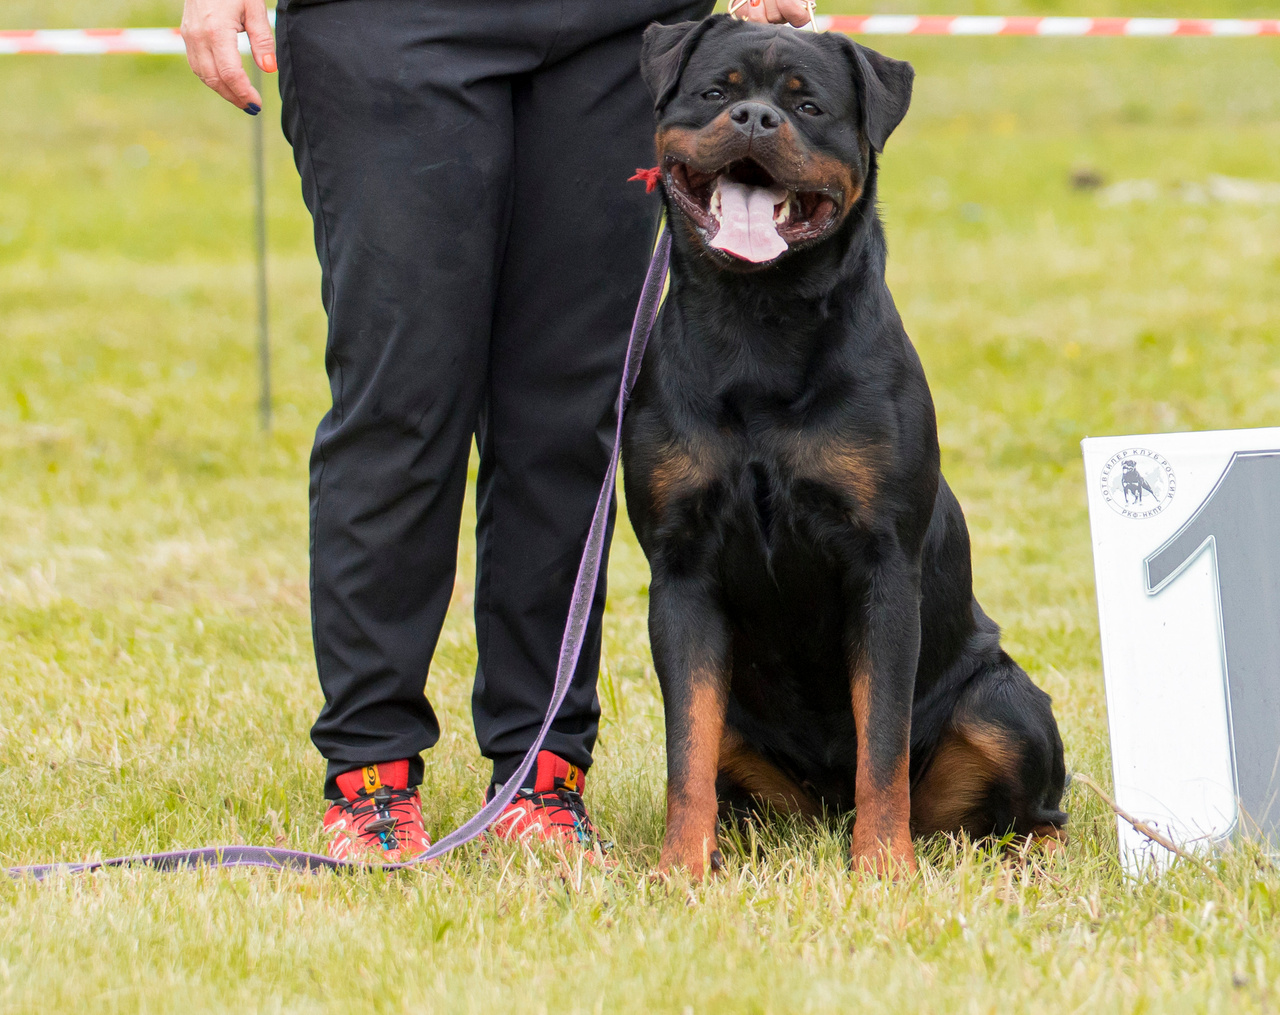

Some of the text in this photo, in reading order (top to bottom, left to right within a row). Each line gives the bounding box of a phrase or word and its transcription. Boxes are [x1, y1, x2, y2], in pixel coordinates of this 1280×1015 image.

[1132, 449, 1160, 460] КЛУБ
[1161, 460, 1176, 499] РОССИИ
[1121, 505, 1162, 518] РКФ-НКПР
